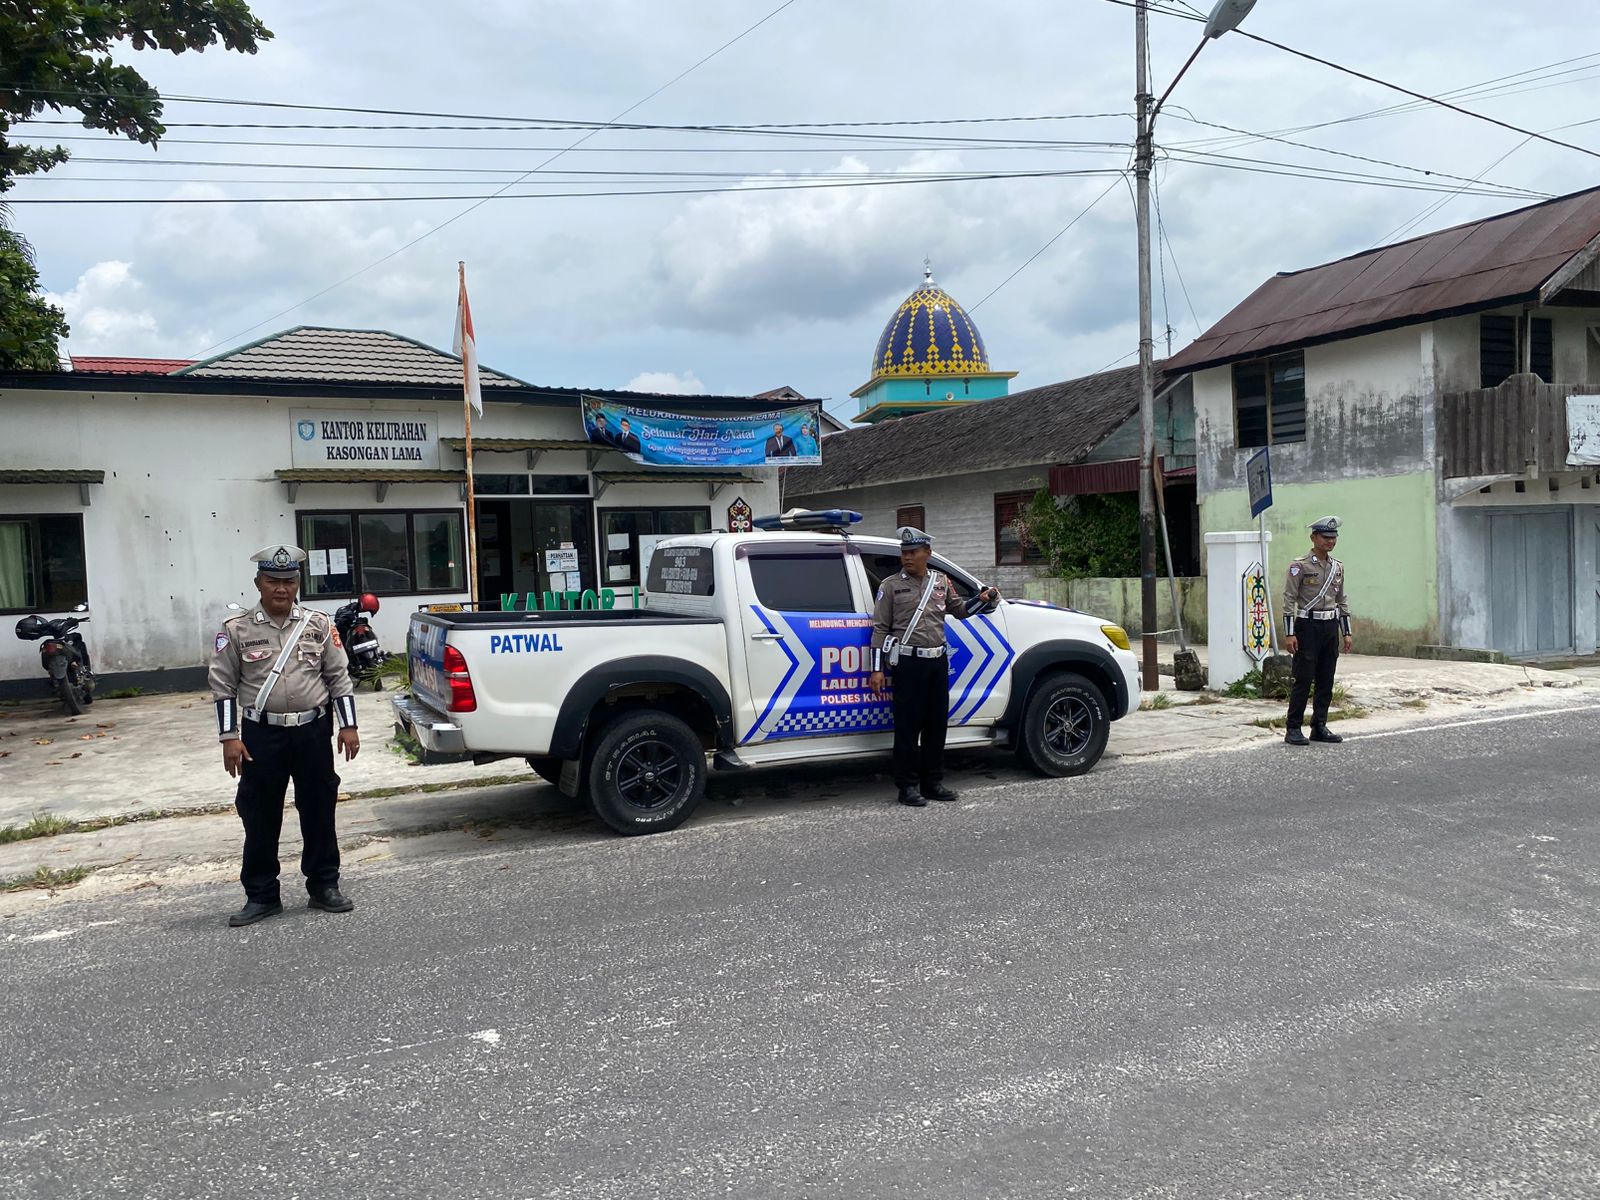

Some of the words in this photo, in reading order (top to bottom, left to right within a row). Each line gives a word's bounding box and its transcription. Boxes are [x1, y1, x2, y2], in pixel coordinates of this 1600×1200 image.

[321, 421, 364, 440] KANTOR
[366, 422, 427, 441] KELURAHAN
[641, 426, 686, 440] Selamat
[688, 428, 719, 441] Hari
[721, 428, 756, 443] Natal
[326, 446, 388, 461] KASONGAN
[391, 447, 423, 461] LAMA
[501, 588, 616, 611] KANTOR
[490, 633, 563, 654] PATWAL
[821, 646, 871, 674] POL
[821, 678, 858, 690] LALU
[821, 694, 861, 705] POLRES
[863, 692, 895, 703] KATIN
